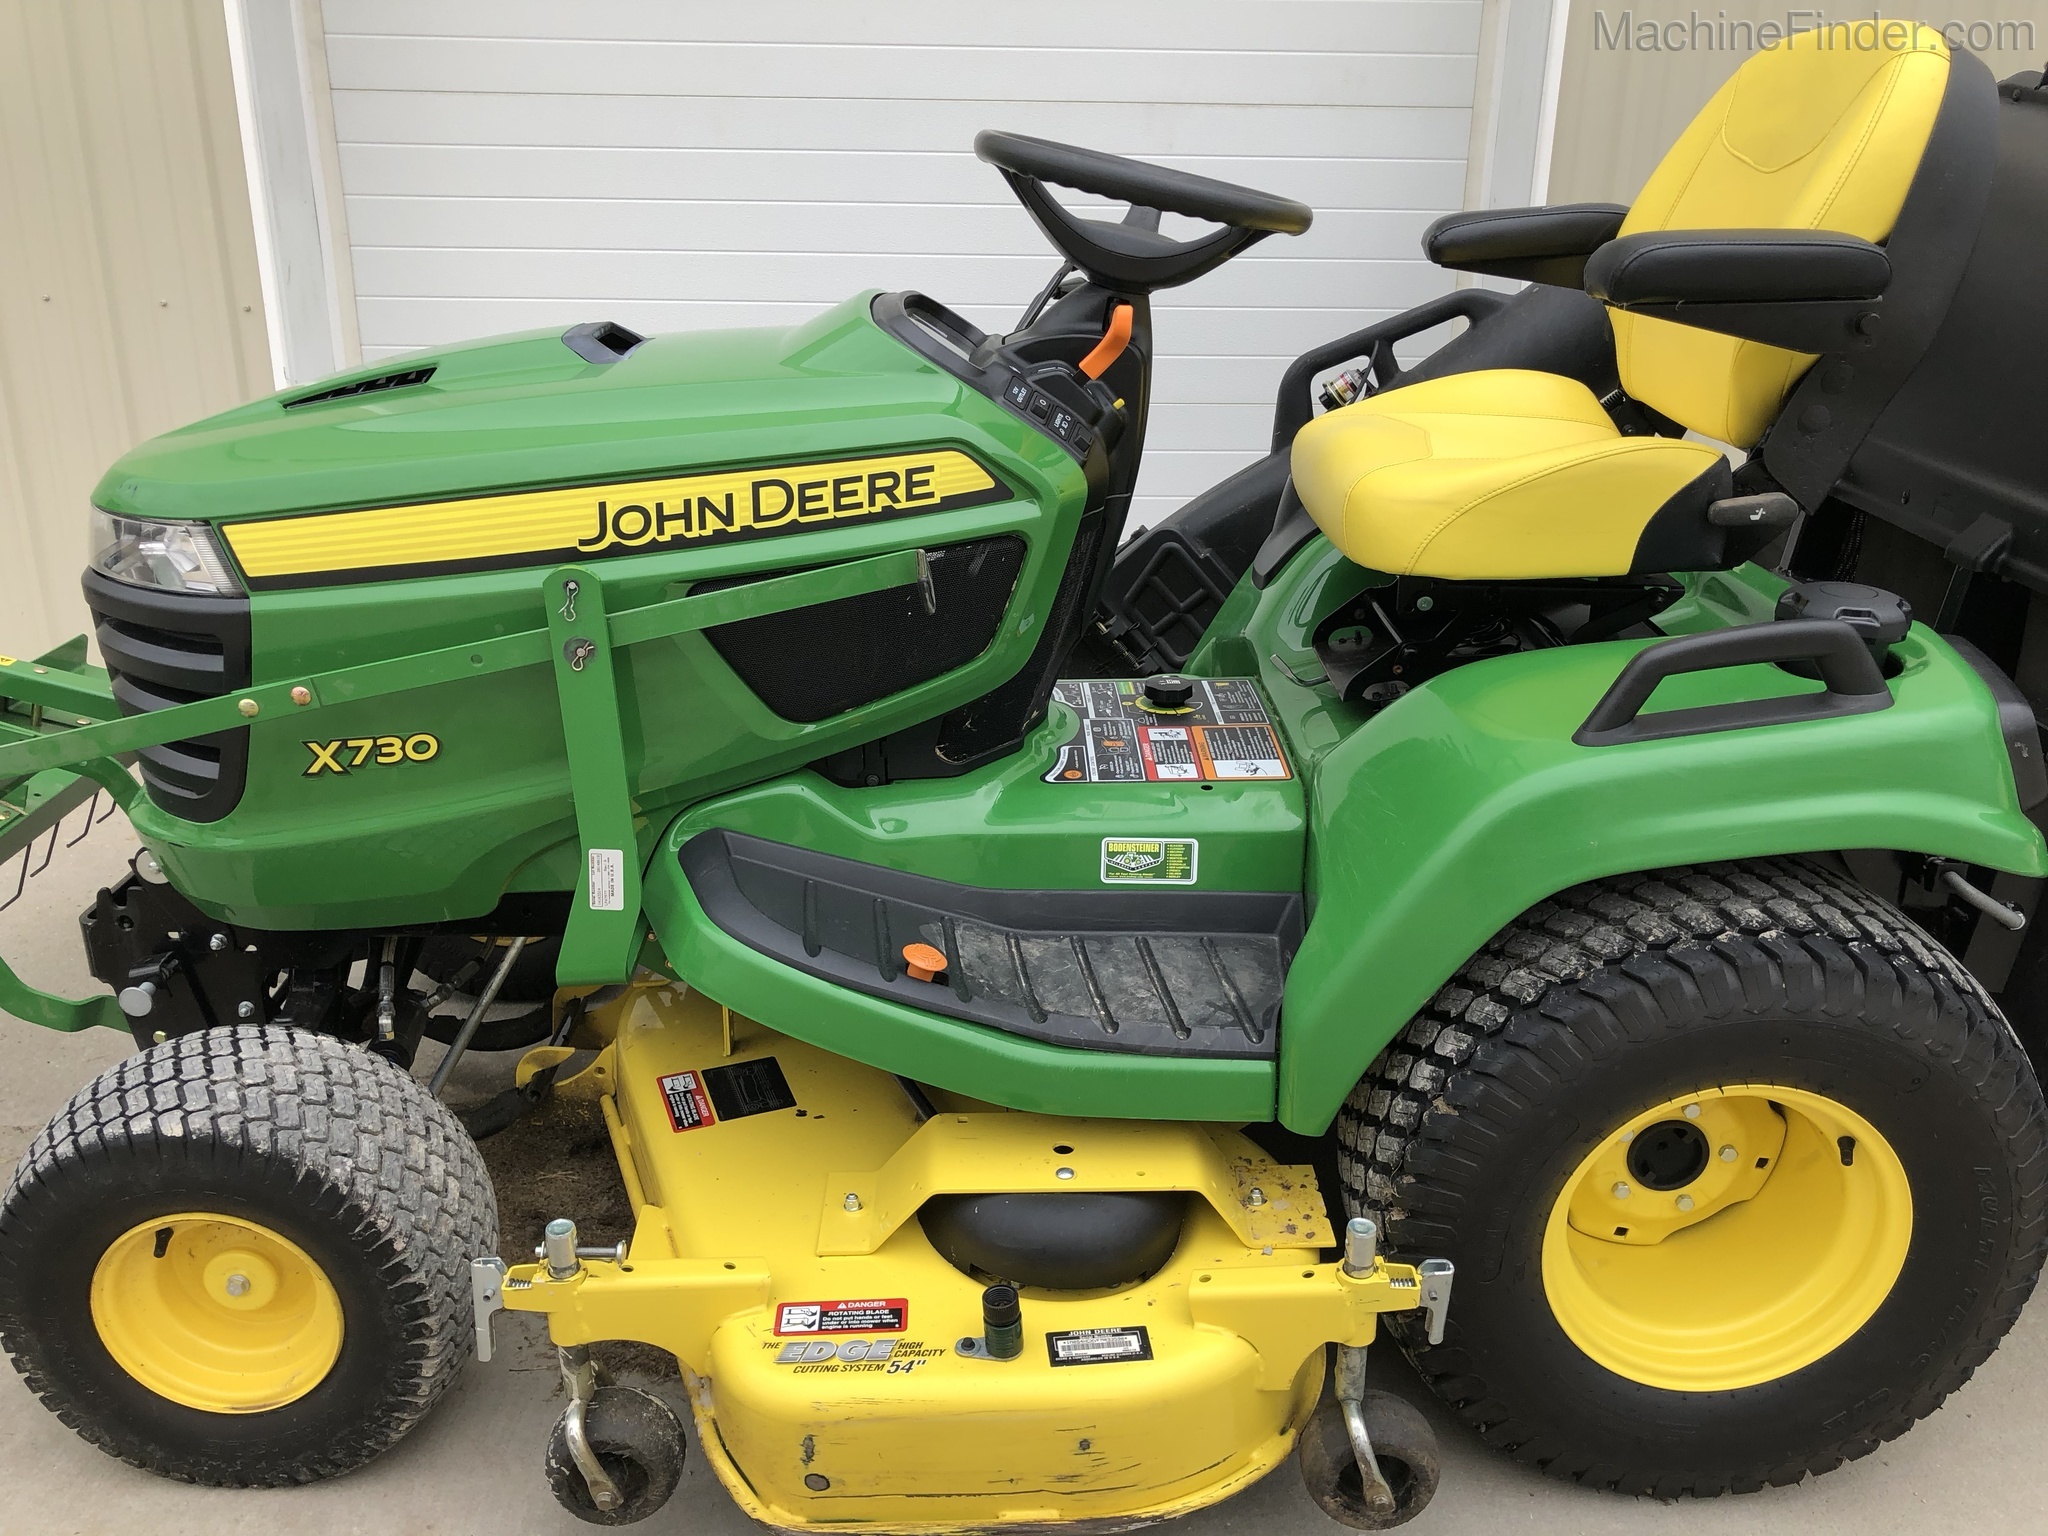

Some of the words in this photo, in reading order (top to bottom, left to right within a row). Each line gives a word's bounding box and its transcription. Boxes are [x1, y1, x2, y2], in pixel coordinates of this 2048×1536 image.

[578, 493, 735, 547] JOHN
[751, 465, 937, 523] DEERE
[302, 733, 440, 776] X730
[1142, 742, 1151, 757] DANGER
[1199, 742, 1208, 757] WARNING
[1108, 843, 1160, 852] BODENSTEINER
[698, 1099, 709, 1117] DANGER
[762, 1341, 782, 1349] THE
[774, 1338, 899, 1364] EDGE
[897, 1342, 924, 1350] HIGH
[893, 1349, 946, 1358] CAPACITY
[793, 1365, 840, 1374] CUTTING
[840, 1363, 886, 1373] SYSTEM
